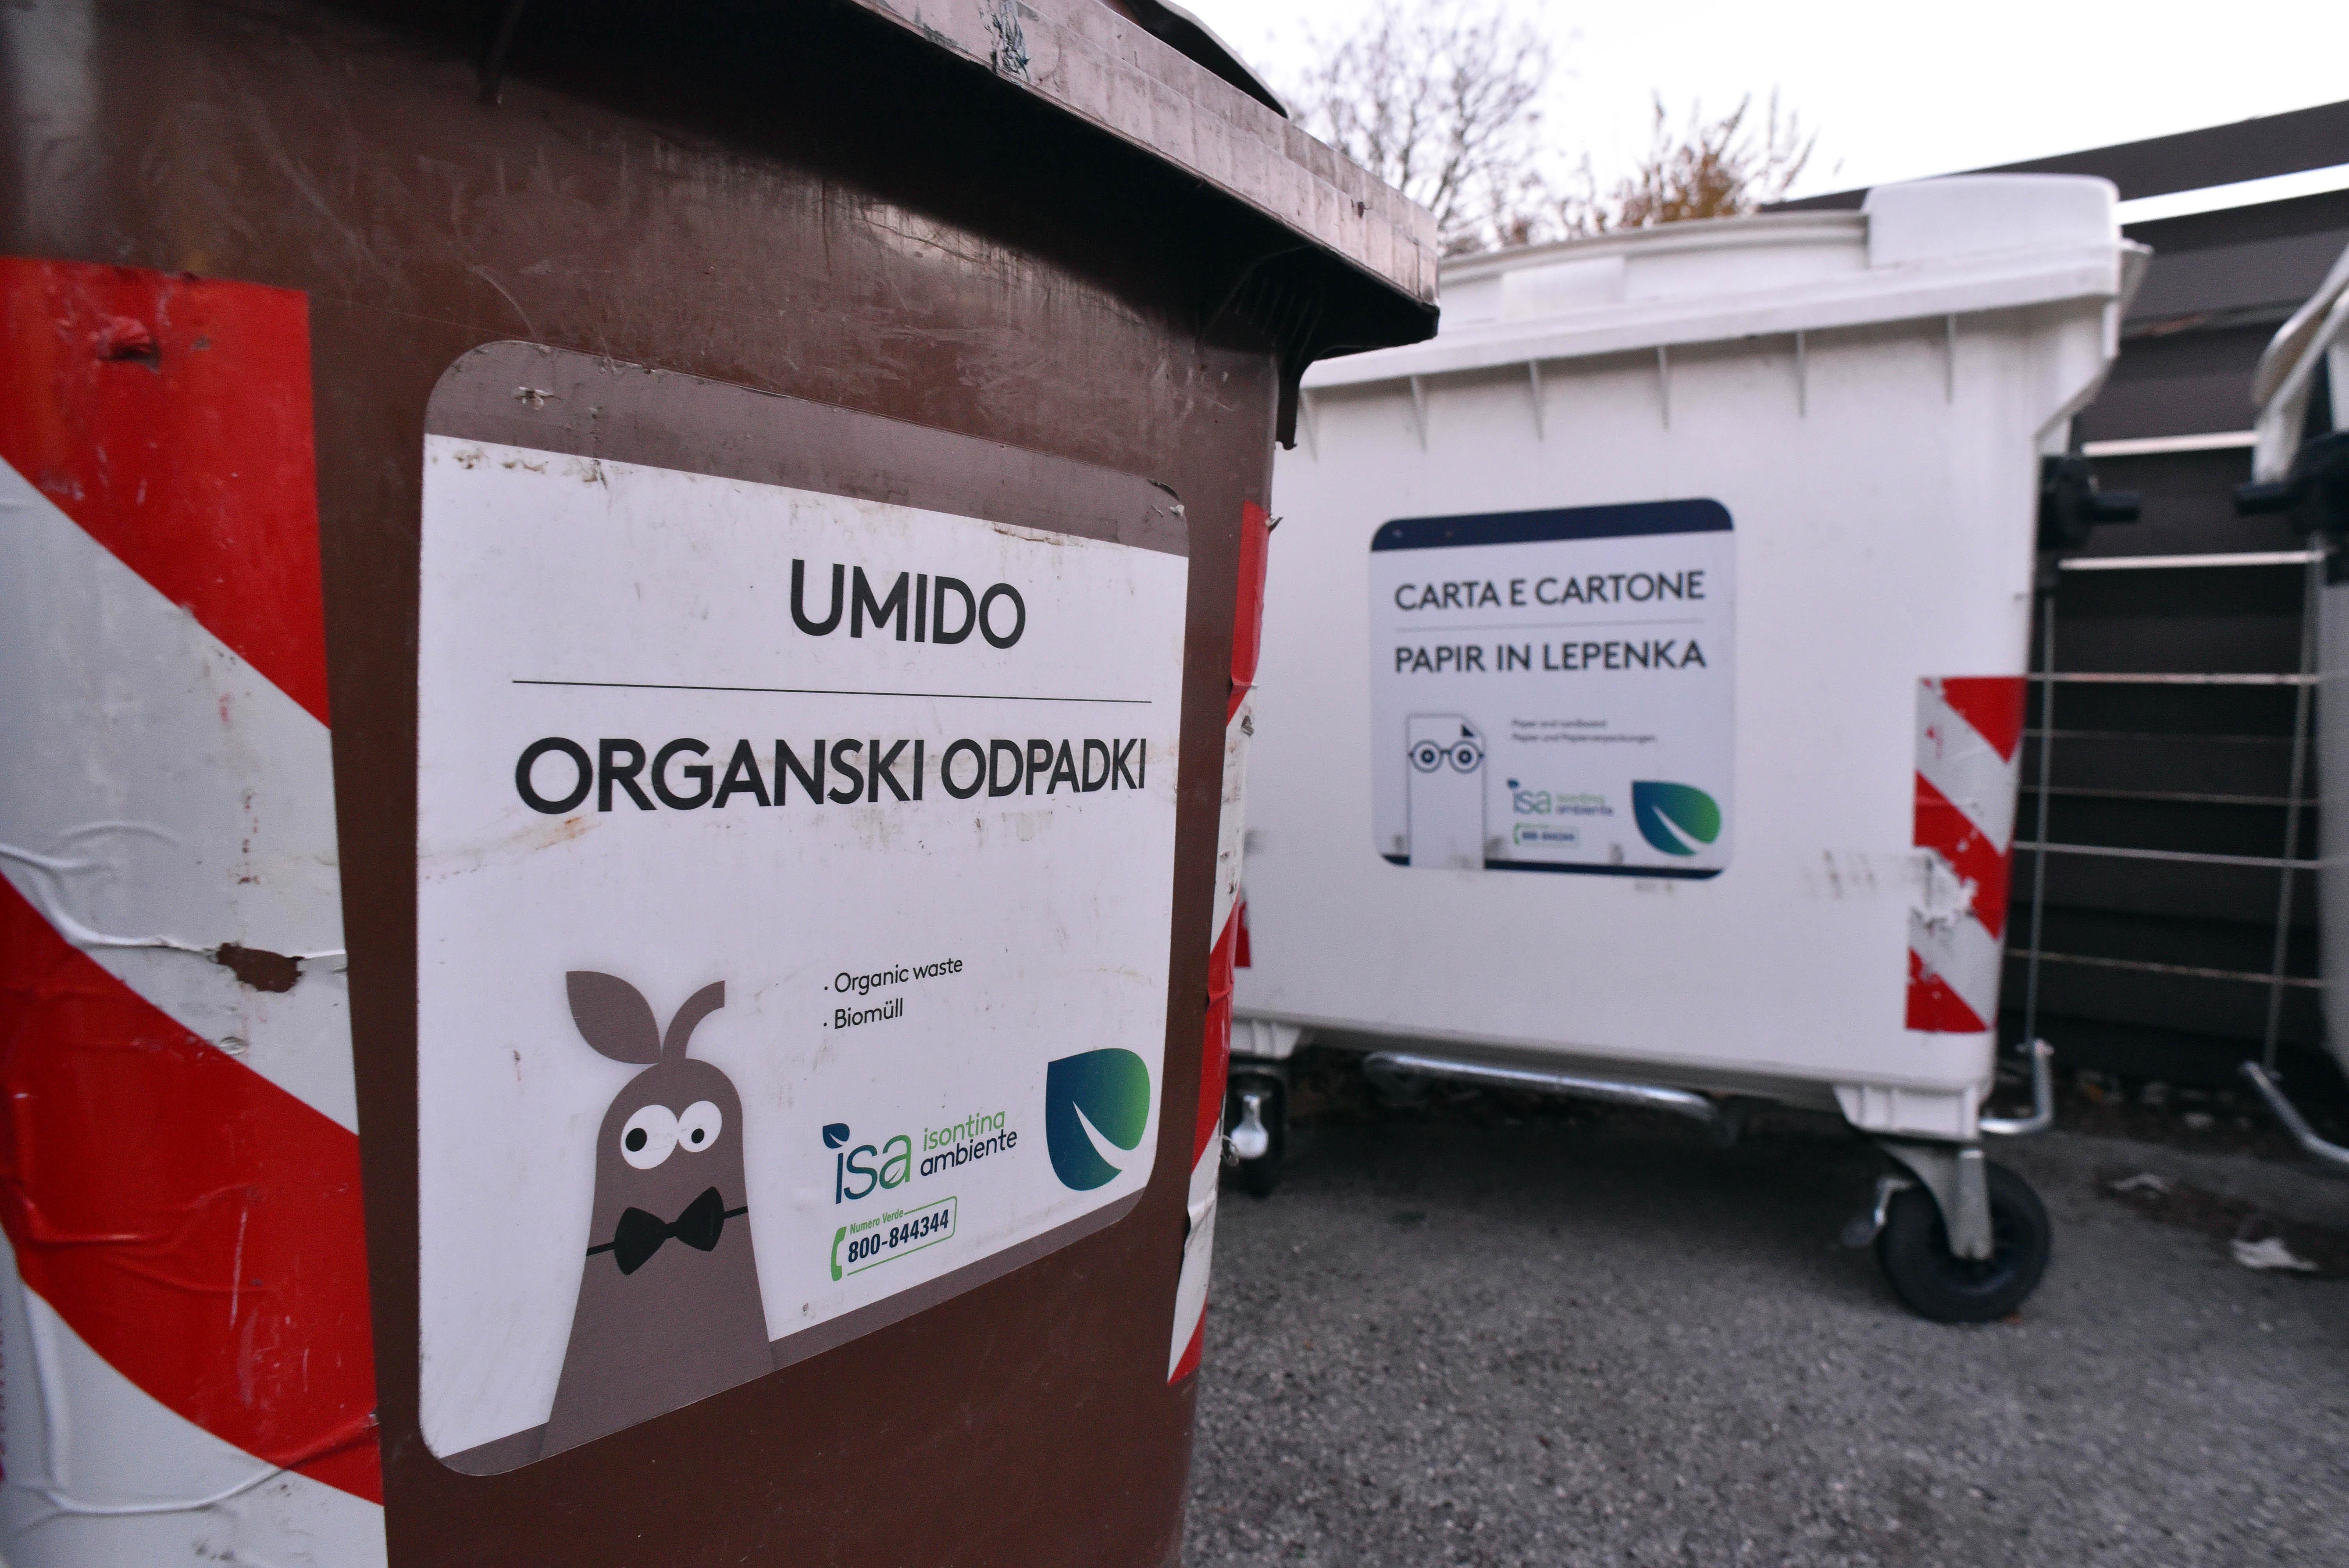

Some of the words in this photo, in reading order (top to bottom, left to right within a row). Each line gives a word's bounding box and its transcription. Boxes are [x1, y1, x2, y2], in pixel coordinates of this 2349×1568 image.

[790, 559, 1026, 649] UMIDO
[1394, 580, 1502, 612] CARTA
[1509, 578, 1527, 607] E
[1534, 570, 1706, 606] CARTONE
[1395, 645, 1486, 674] PAPIR
[1496, 643, 1531, 672] IN
[1543, 640, 1707, 672] LEPENKA
[515, 737, 924, 815] ORGANSKI
[941, 738, 1147, 799] ODPADKI
[834, 964, 909, 996] Organic
[913, 958, 963, 980] waste
[834, 997, 903, 1030] Biomüll
[923, 1111, 1005, 1151] isontina
[822, 1123, 912, 1205] isa
[920, 1129, 1018, 1177] ambiente
[848, 1209, 949, 1263] 800-844344
[850, 1217, 880, 1235] Numero
[882, 1208, 904, 1224] Verde
